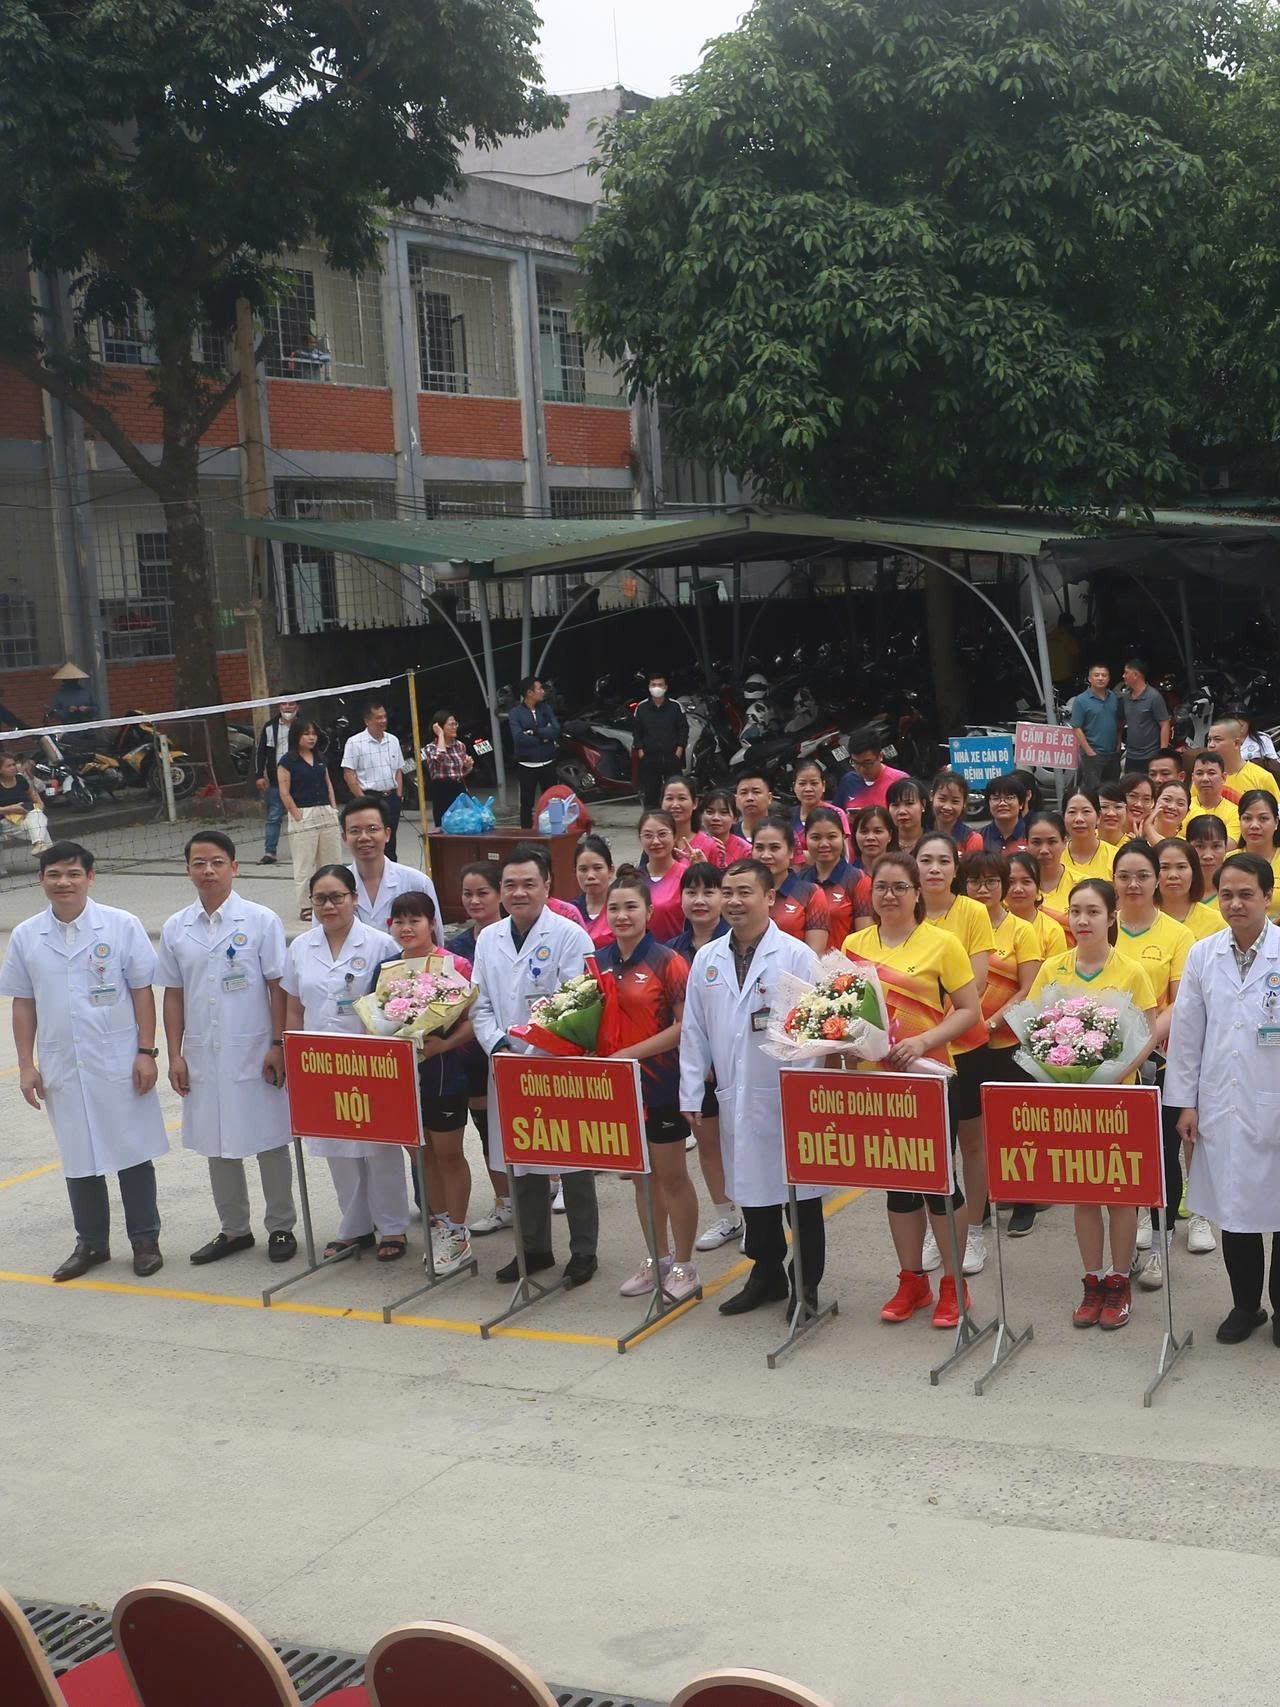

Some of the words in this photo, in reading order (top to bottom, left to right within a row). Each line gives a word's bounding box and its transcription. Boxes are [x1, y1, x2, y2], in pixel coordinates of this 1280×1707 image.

[953, 749, 970, 763] NHÀ
[971, 751, 980, 762] XE
[981, 748, 998, 763] CÁN
[999, 748, 1009, 764] BỘ
[1061, 733, 1074, 747] XE
[1039, 750, 1051, 763] RA
[1054, 750, 1073, 765] VÀO
[964, 766, 984, 782] BỆNH
[300, 1047, 333, 1074] CÔNG
[335, 1050, 368, 1076] ĐOÀN
[369, 1049, 399, 1079] KHỐI
[520, 1069, 551, 1097] CÔNG
[552, 1070, 585, 1099] ĐOÀN
[585, 1069, 614, 1101] KHỐI
[334, 1086, 371, 1129] NỘI
[809, 1084, 845, 1114] CÔNG
[847, 1087, 884, 1117] ĐOÀN
[886, 1086, 918, 1119] KHỐI
[1012, 1101, 1050, 1132] CÔNG
[1053, 1103, 1092, 1133] ĐOÀN
[1095, 1101, 1129, 1134] KHỐI
[511, 1106, 571, 1153] SẢN
[578, 1120, 630, 1157] NHI
[797, 1121, 856, 1167] ĐIỀU
[863, 1128, 936, 1172] HÀNH
[1000, 1140, 1038, 1182] KỸ
[1047, 1143, 1143, 1193] THUẬT
